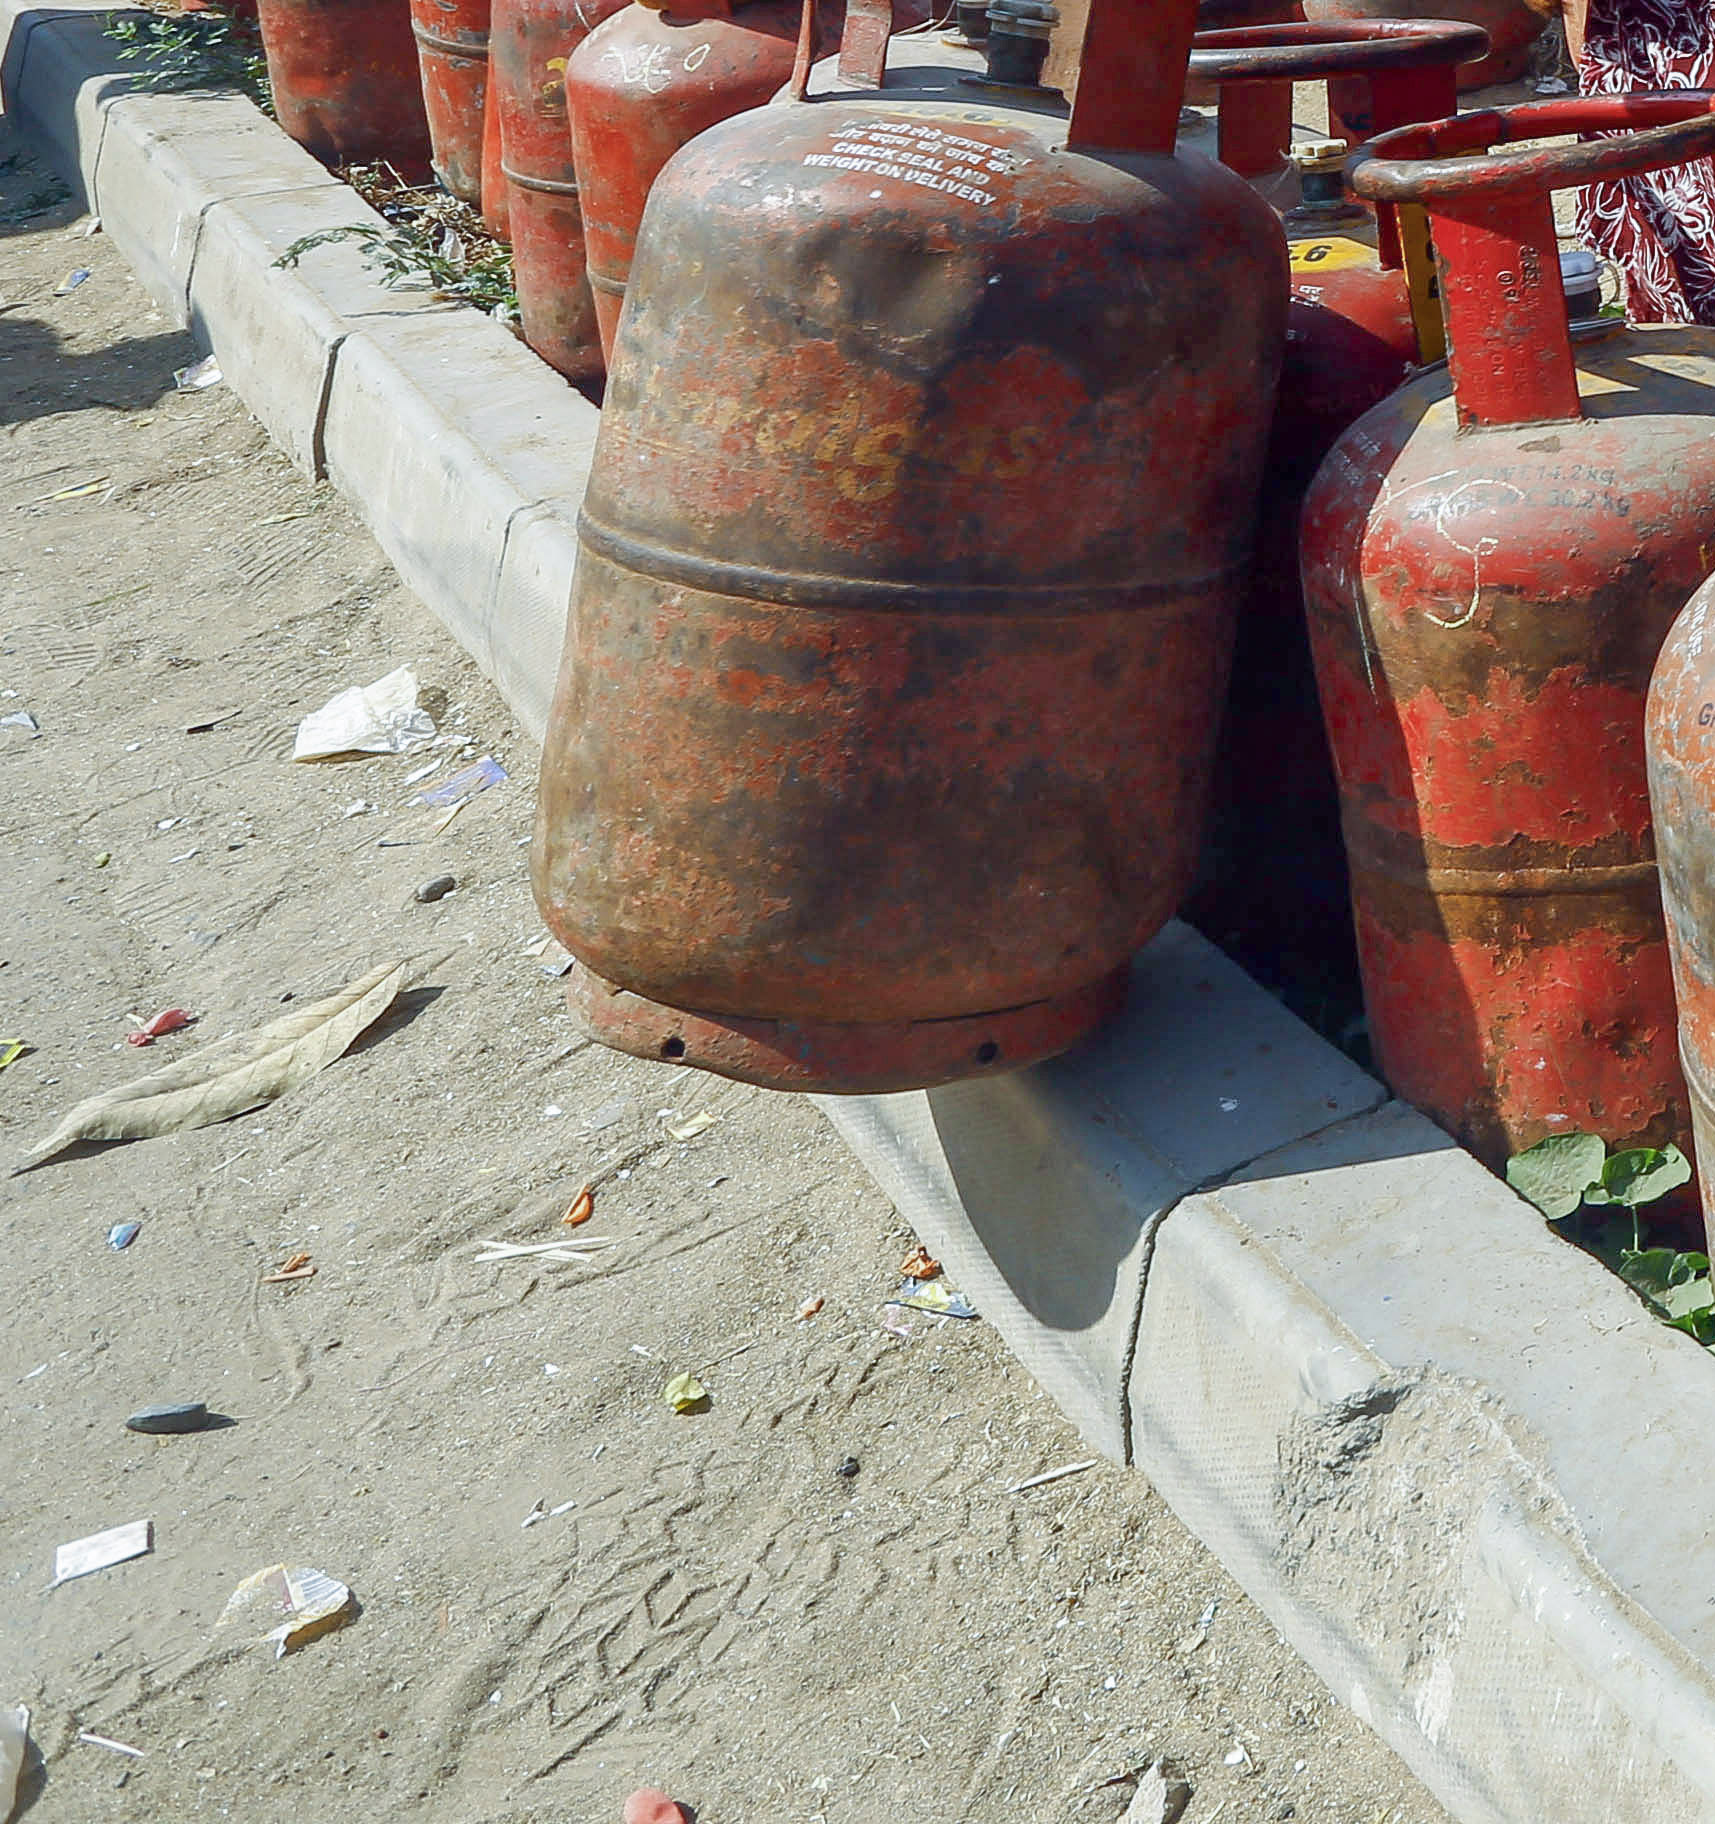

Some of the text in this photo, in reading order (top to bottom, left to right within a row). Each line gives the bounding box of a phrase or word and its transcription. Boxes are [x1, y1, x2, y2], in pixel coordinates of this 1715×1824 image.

[803, 153, 998, 207] WEIGHT ON DELIVERY
[831, 141, 991, 187] CHECK SEAL AND
